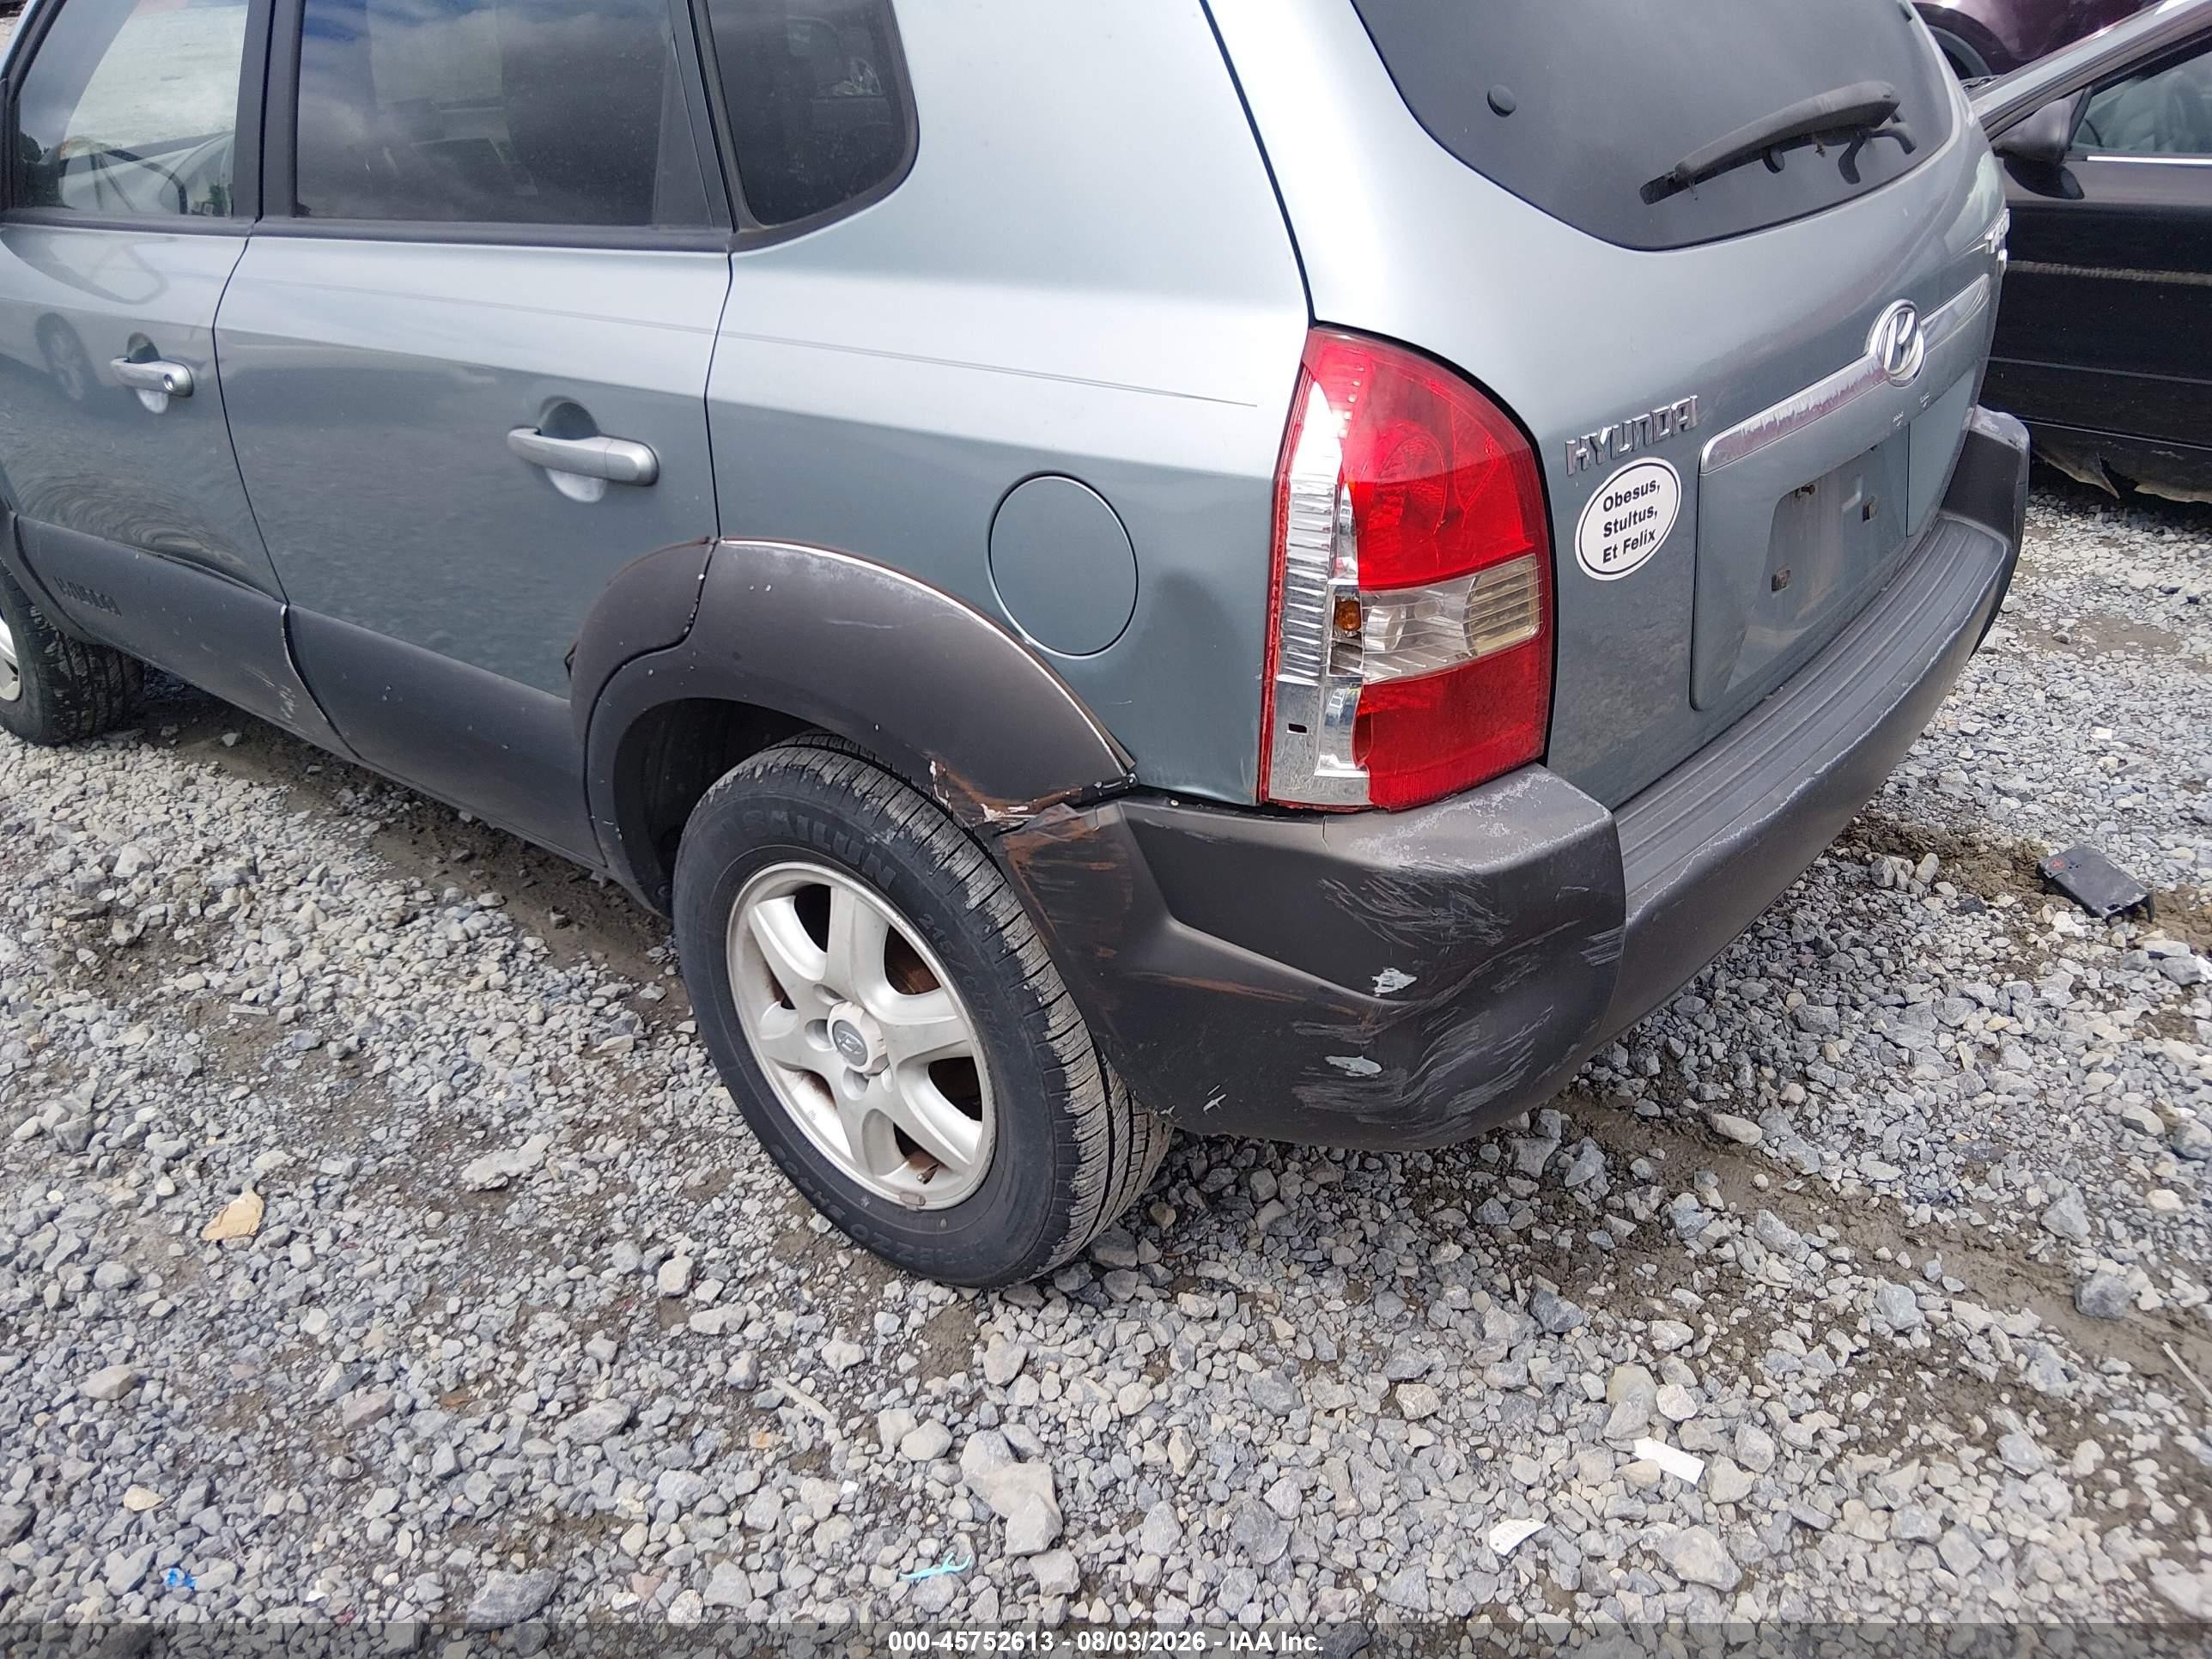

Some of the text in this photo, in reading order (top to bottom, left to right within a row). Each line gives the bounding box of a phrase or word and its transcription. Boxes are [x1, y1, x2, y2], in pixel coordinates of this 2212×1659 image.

[1565, 395, 1698, 476] HYUNDAI
[1602, 479, 1661, 512] Obesus,
[1602, 505, 1658, 538] Stultus,
[1602, 527, 1656, 563] Et Felix
